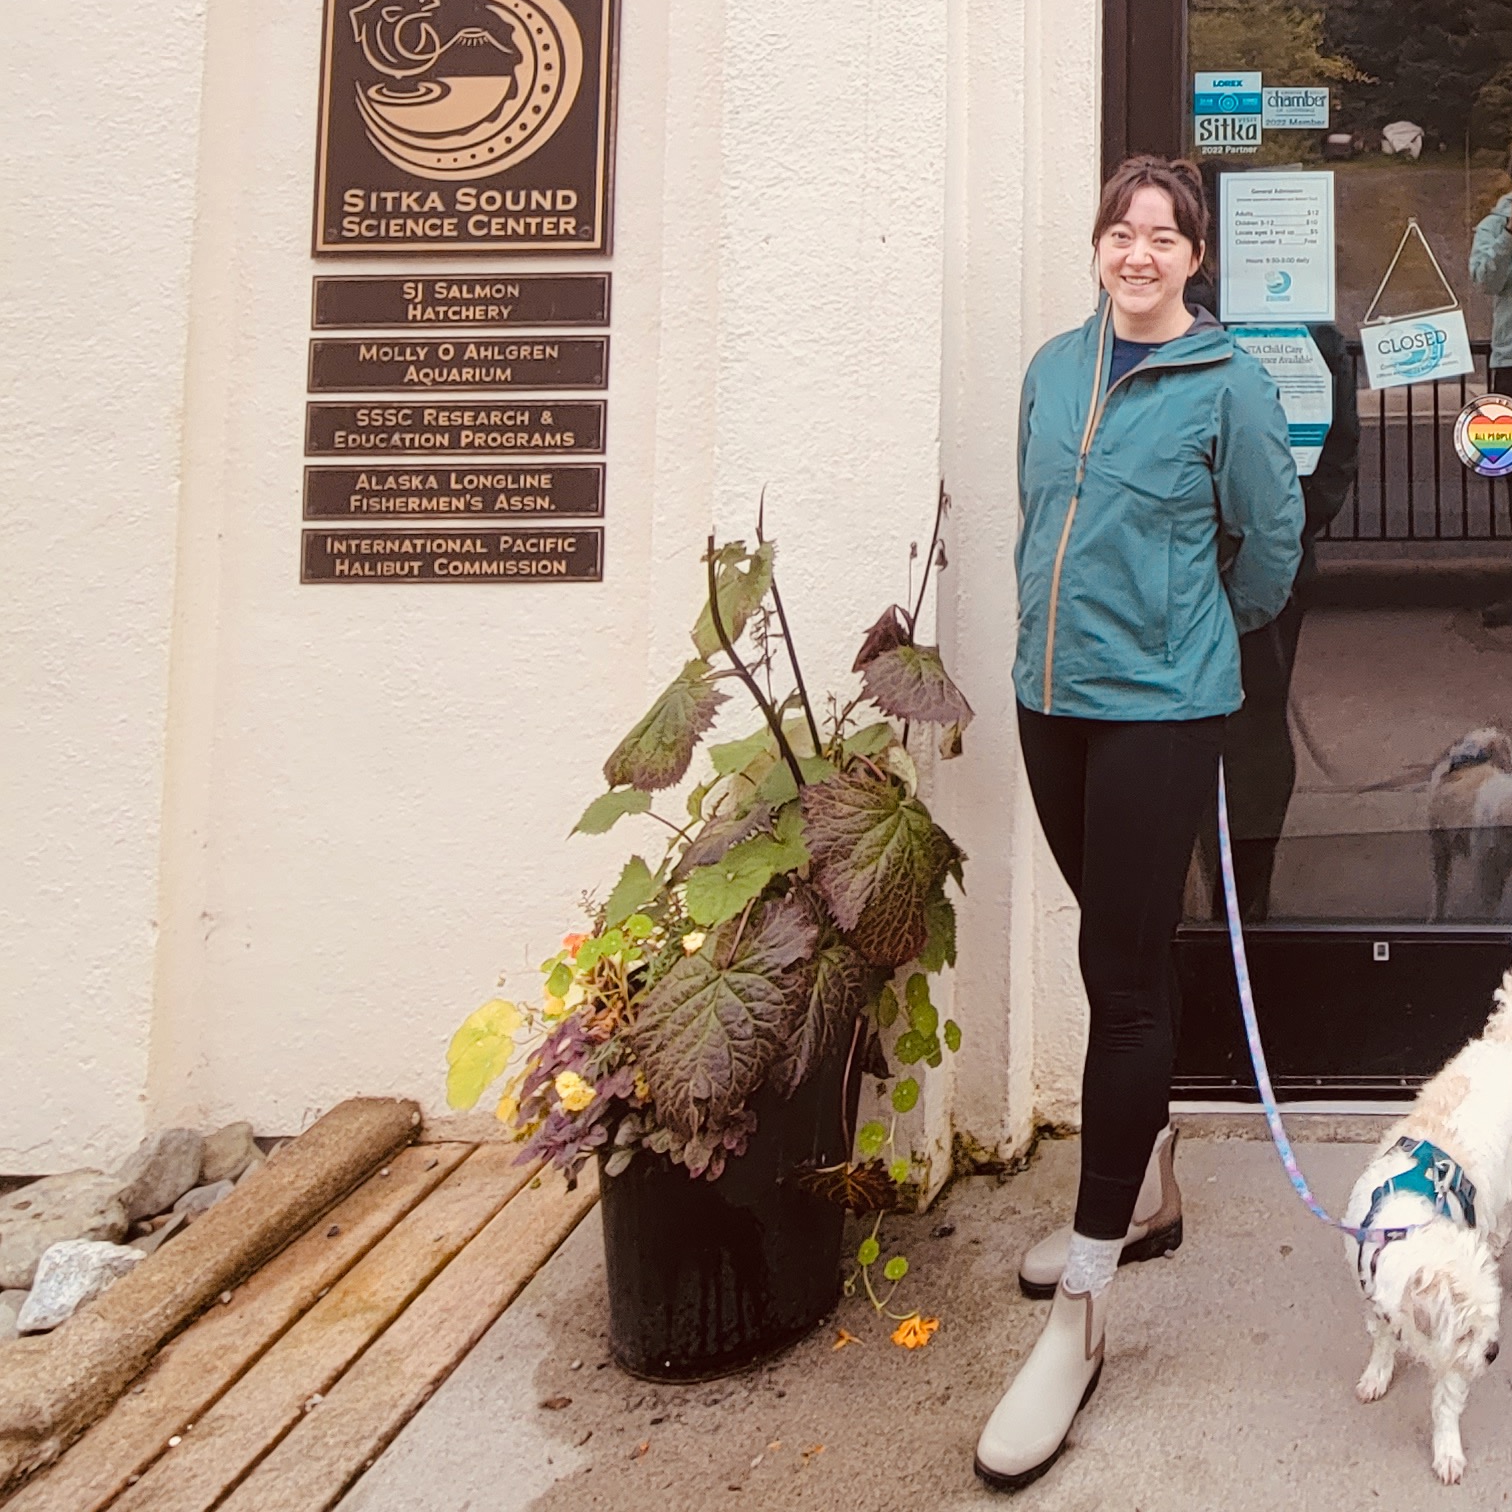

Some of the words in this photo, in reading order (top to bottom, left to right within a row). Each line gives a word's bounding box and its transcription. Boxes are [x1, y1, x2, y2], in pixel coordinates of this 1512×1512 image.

[1267, 90, 1328, 107] chamber
[1289, 118, 1326, 126] Member
[1225, 145, 1258, 154] Partner
[342, 188, 445, 213] SITKA
[455, 187, 578, 212] SOUND
[341, 215, 458, 238] SCIENCE
[467, 214, 577, 237] CENTER
[403, 281, 424, 303] SJ
[434, 282, 520, 300] SALMON
[407, 304, 513, 321] HATCHERY
[1378, 329, 1448, 355] CLOSED
[358, 344, 428, 362] MOLLY
[438, 343, 455, 361] O
[464, 343, 559, 360] AHLGREN
[403, 365, 512, 386] AQUARIUM
[356, 409, 413, 427] SSSC
[423, 409, 530, 426] RESEARCH
[540, 409, 554, 426] &
[333, 431, 449, 449] EDUCATION
[460, 430, 576, 448] PROGRAMS
[355, 472, 438, 491] ALASKA
[449, 472, 553, 490] LONGLINE
[350, 494, 483, 513] FISHERMEN'S
[494, 493, 557, 511] ASSN.
[325, 536, 488, 555] INTERNATIONAL
[499, 535, 577, 553] PACIFIC
[335, 559, 423, 576] HALIBUT
[433, 557, 567, 576] COMMISSION
